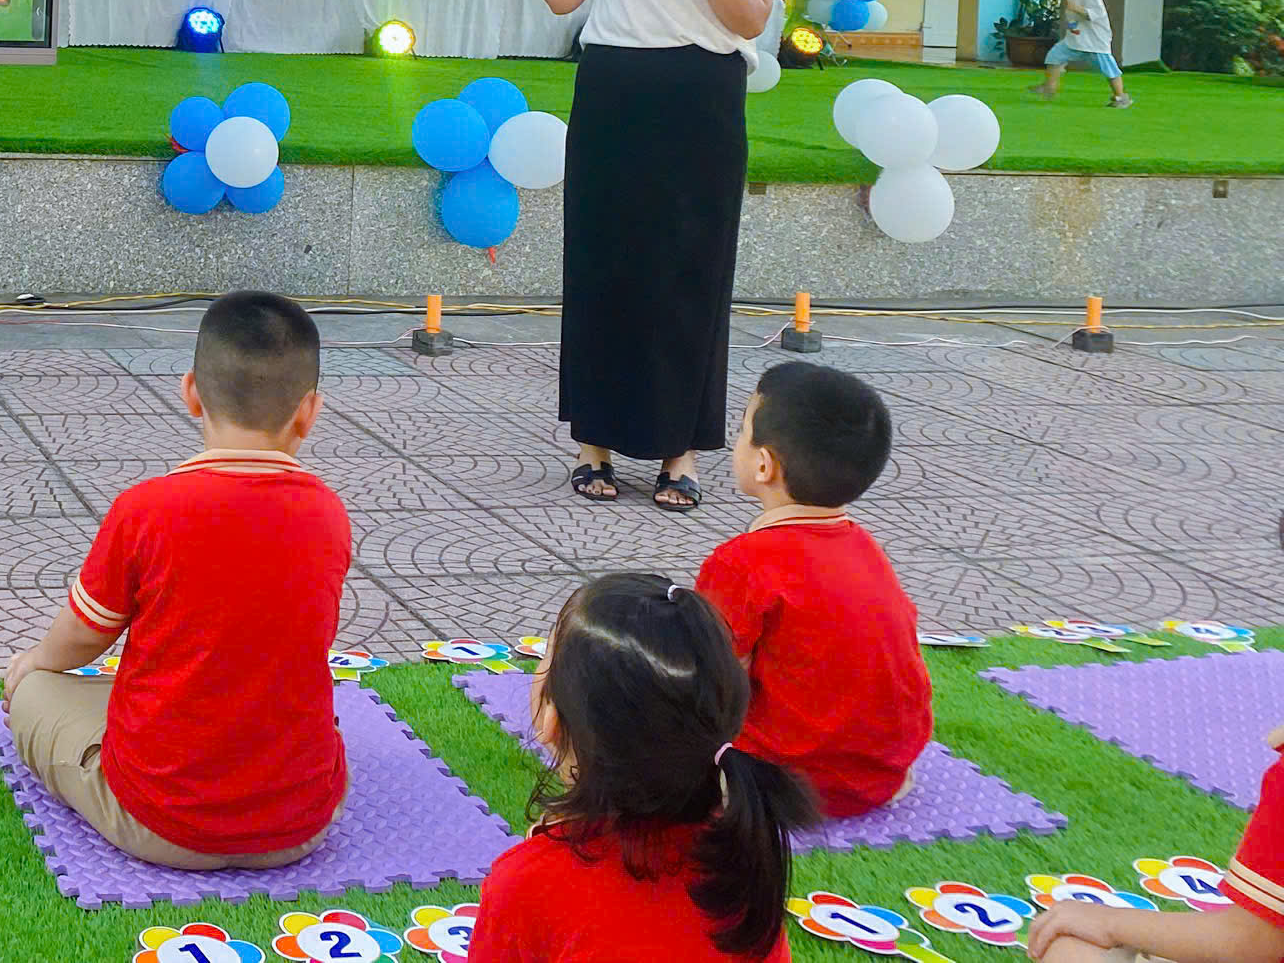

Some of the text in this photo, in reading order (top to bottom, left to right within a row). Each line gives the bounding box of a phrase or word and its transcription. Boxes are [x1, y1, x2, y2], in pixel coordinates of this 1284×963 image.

[329, 655, 351, 666] 4
[452, 645, 481, 656] 1
[1179, 875, 1224, 898] 4
[830, 911, 880, 935] 1
[954, 901, 1013, 928] 2
[178, 943, 213, 963] 1
[319, 930, 363, 959] 2
